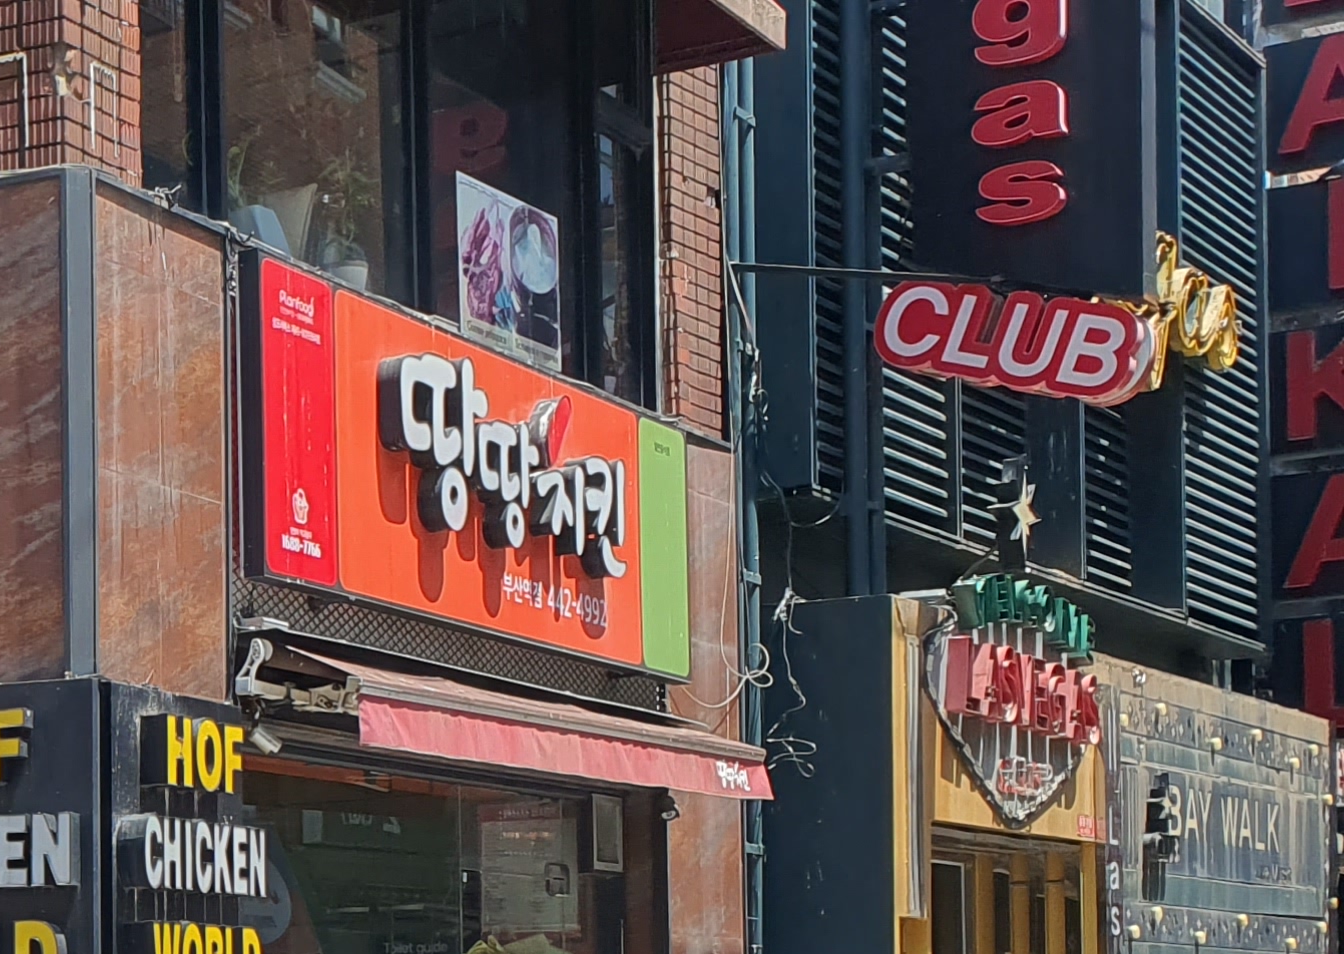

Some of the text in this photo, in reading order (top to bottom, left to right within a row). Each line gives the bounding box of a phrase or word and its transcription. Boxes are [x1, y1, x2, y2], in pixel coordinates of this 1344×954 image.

[882, 287, 1127, 388] CLUB
[390, 353, 627, 578] 땅땅치킨
[502, 572, 609, 627] 부산역점 442-4992
[165, 714, 244, 794] HOF
[144, 815, 268, 898] CHICKEN
[1167, 784, 1280, 853] BAY WALK
